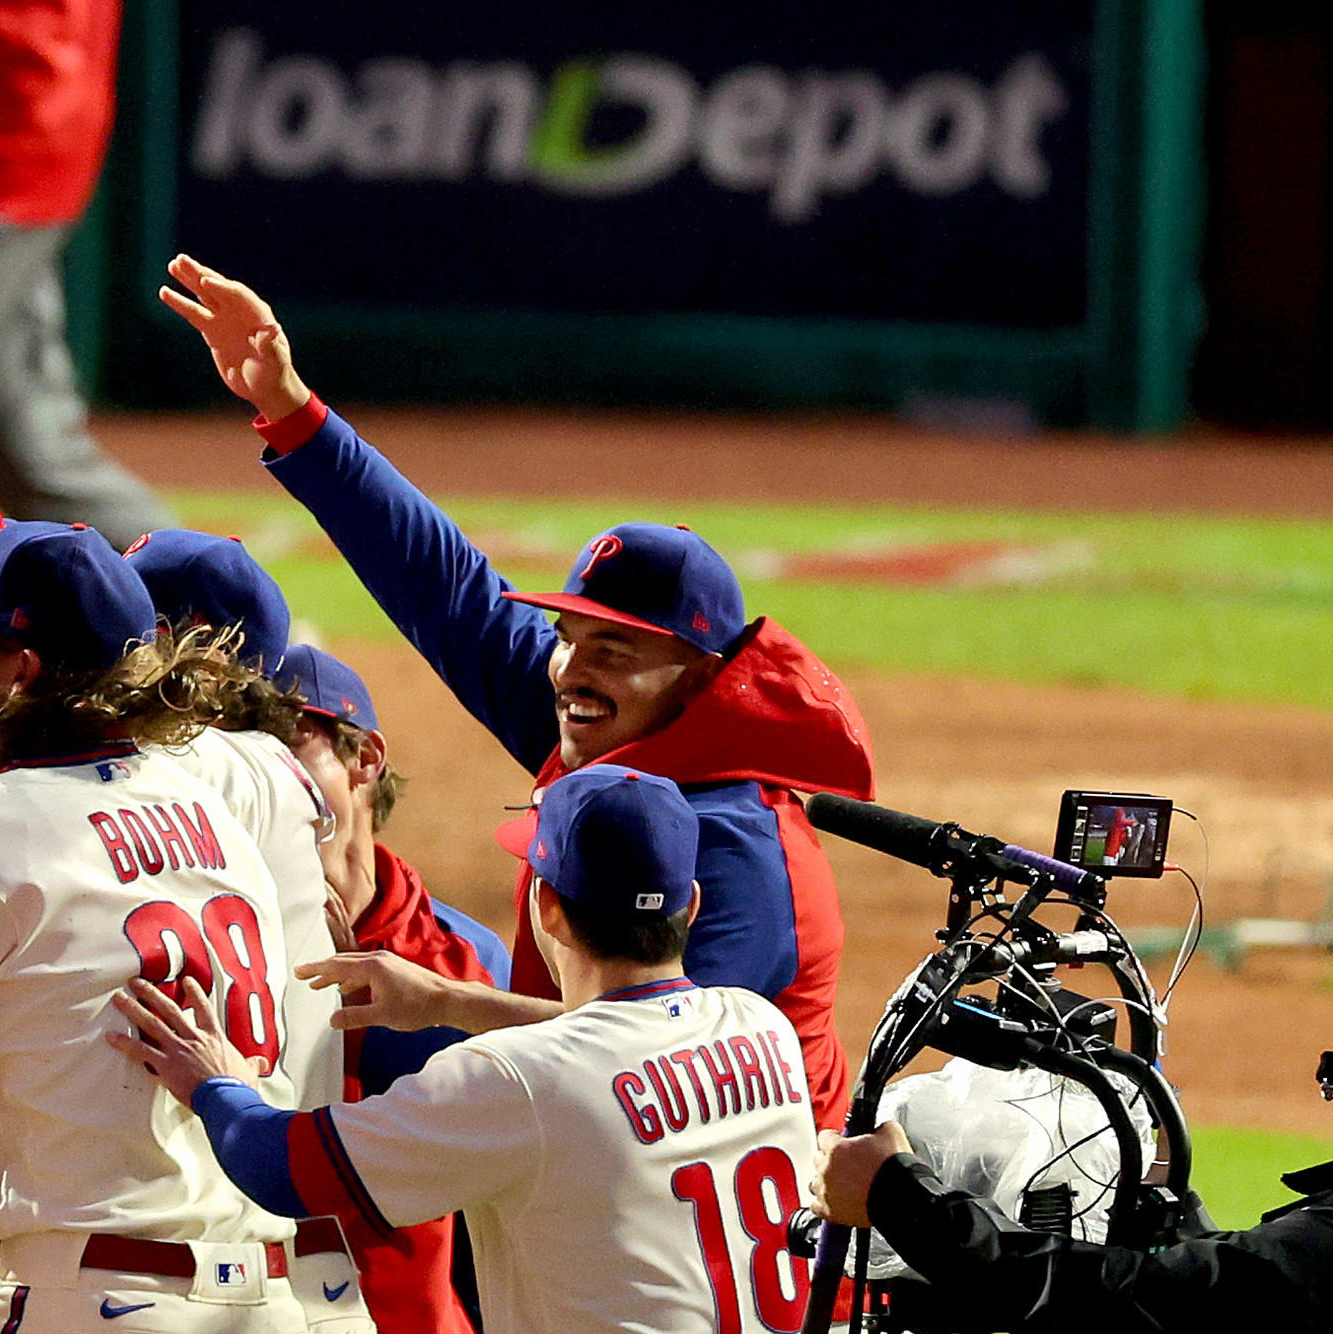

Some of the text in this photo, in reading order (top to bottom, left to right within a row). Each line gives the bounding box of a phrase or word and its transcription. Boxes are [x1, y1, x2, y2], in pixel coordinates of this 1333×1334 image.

[192, 30, 1067, 223] loanDepot
[579, 534, 623, 580] P
[88, 801, 226, 885] BOHM
[123, 893, 281, 1078] 28
[612, 1029, 802, 1145] GUTHRIE
